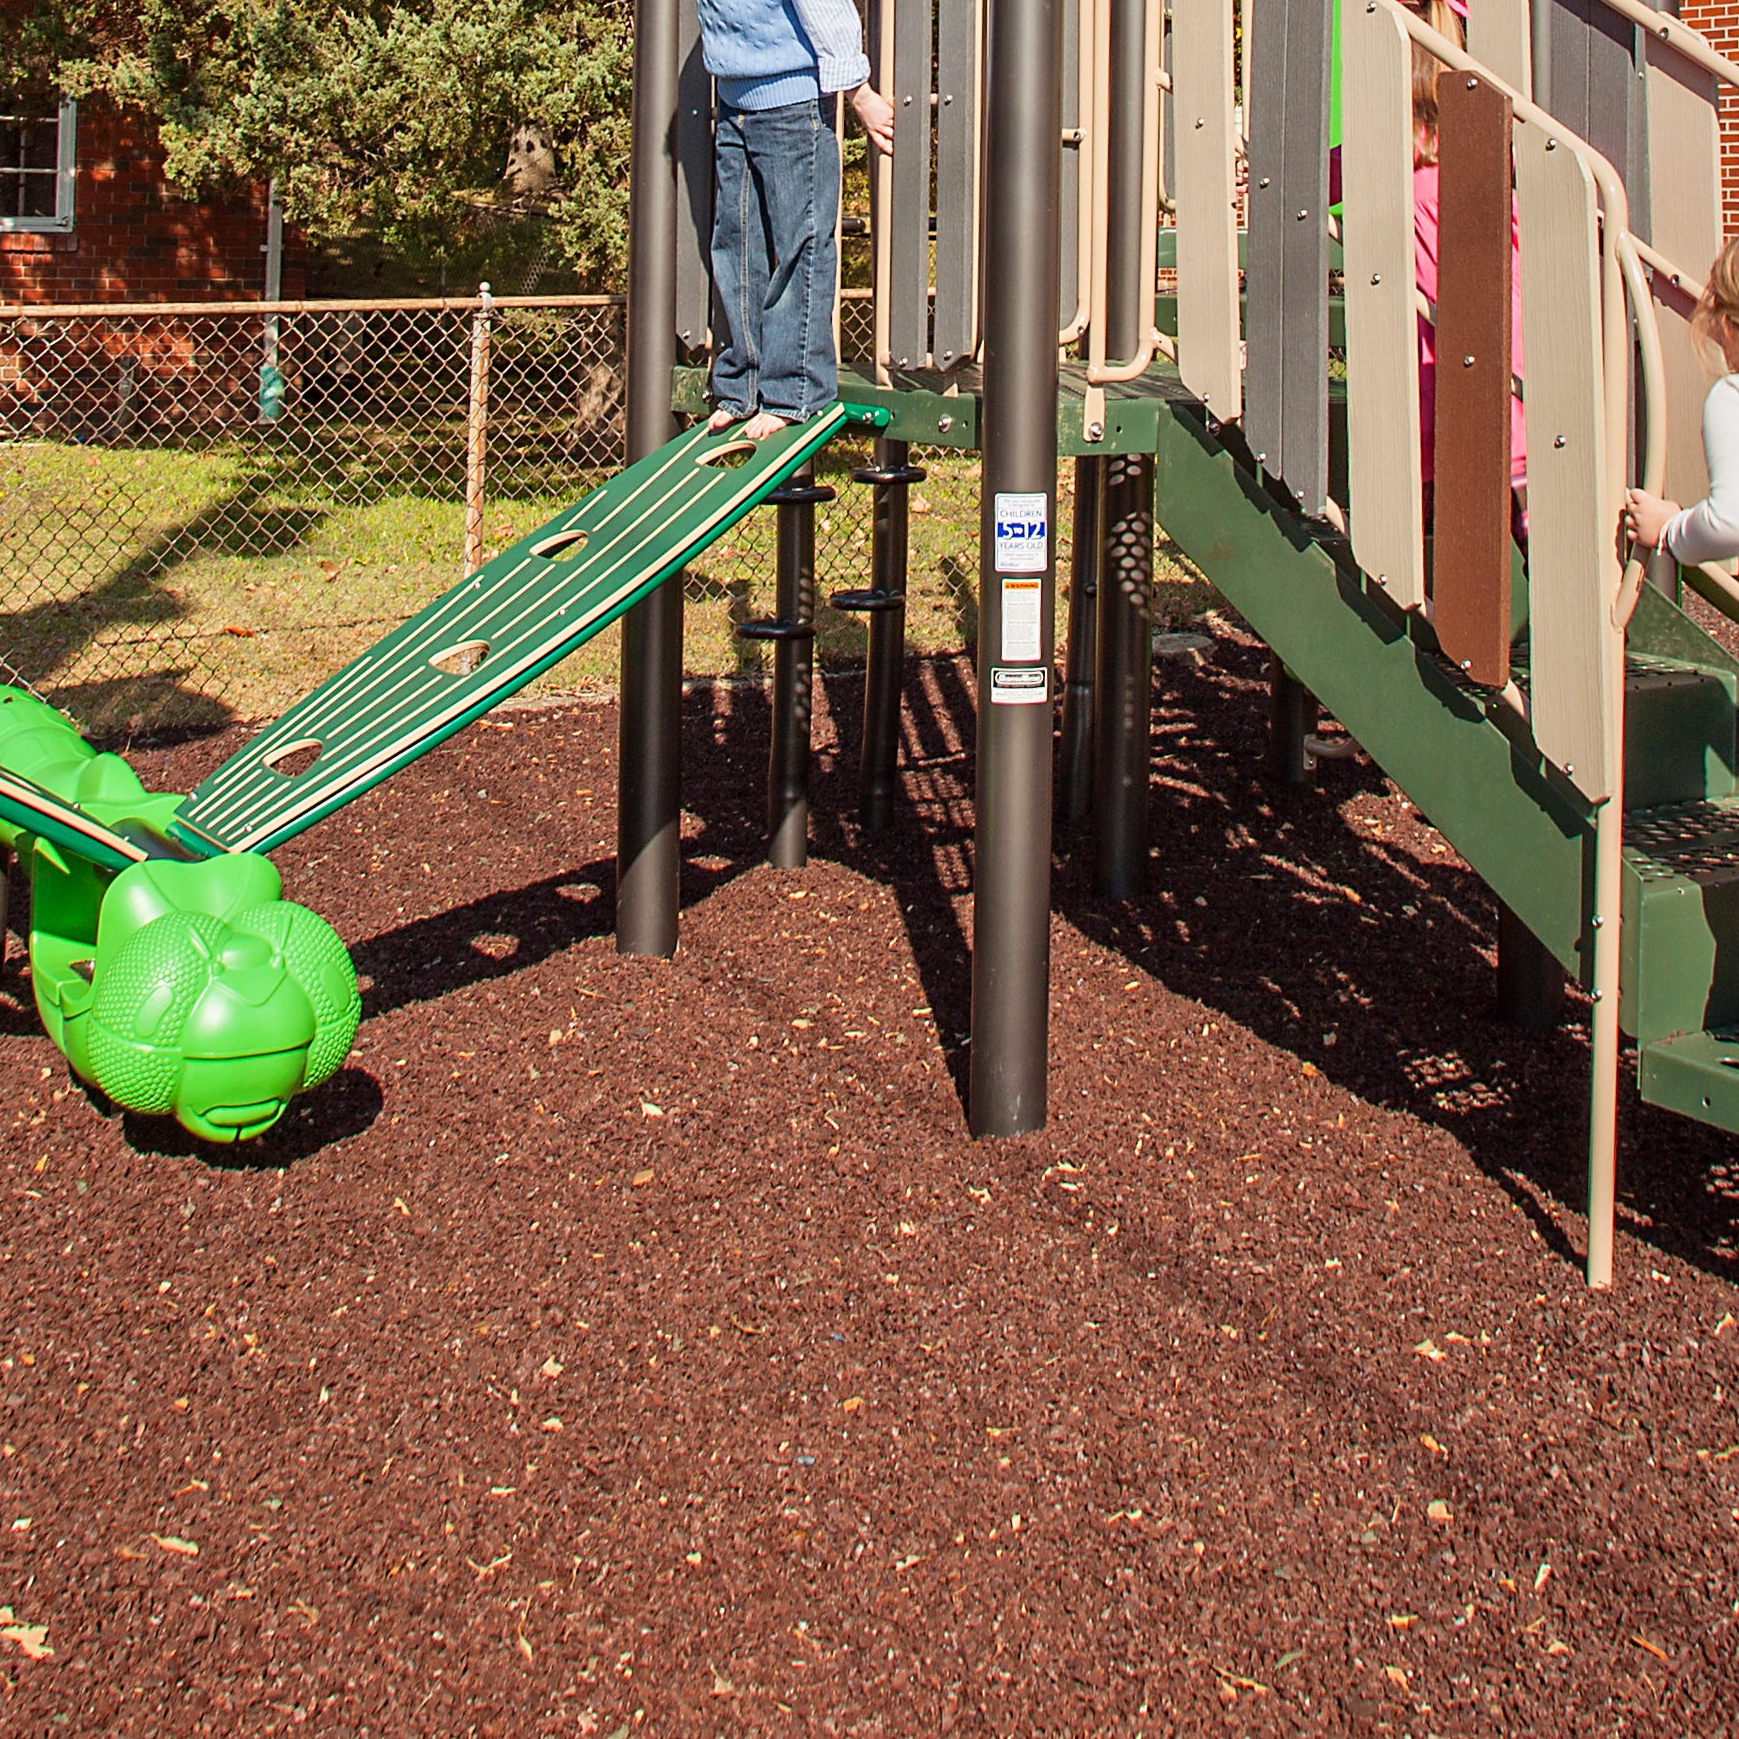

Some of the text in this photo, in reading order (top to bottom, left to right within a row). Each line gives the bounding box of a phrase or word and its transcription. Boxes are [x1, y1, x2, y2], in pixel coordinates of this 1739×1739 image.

[1000, 509, 1042, 517] CHILDREN
[1000, 541, 1043, 549] YEARS OLD
